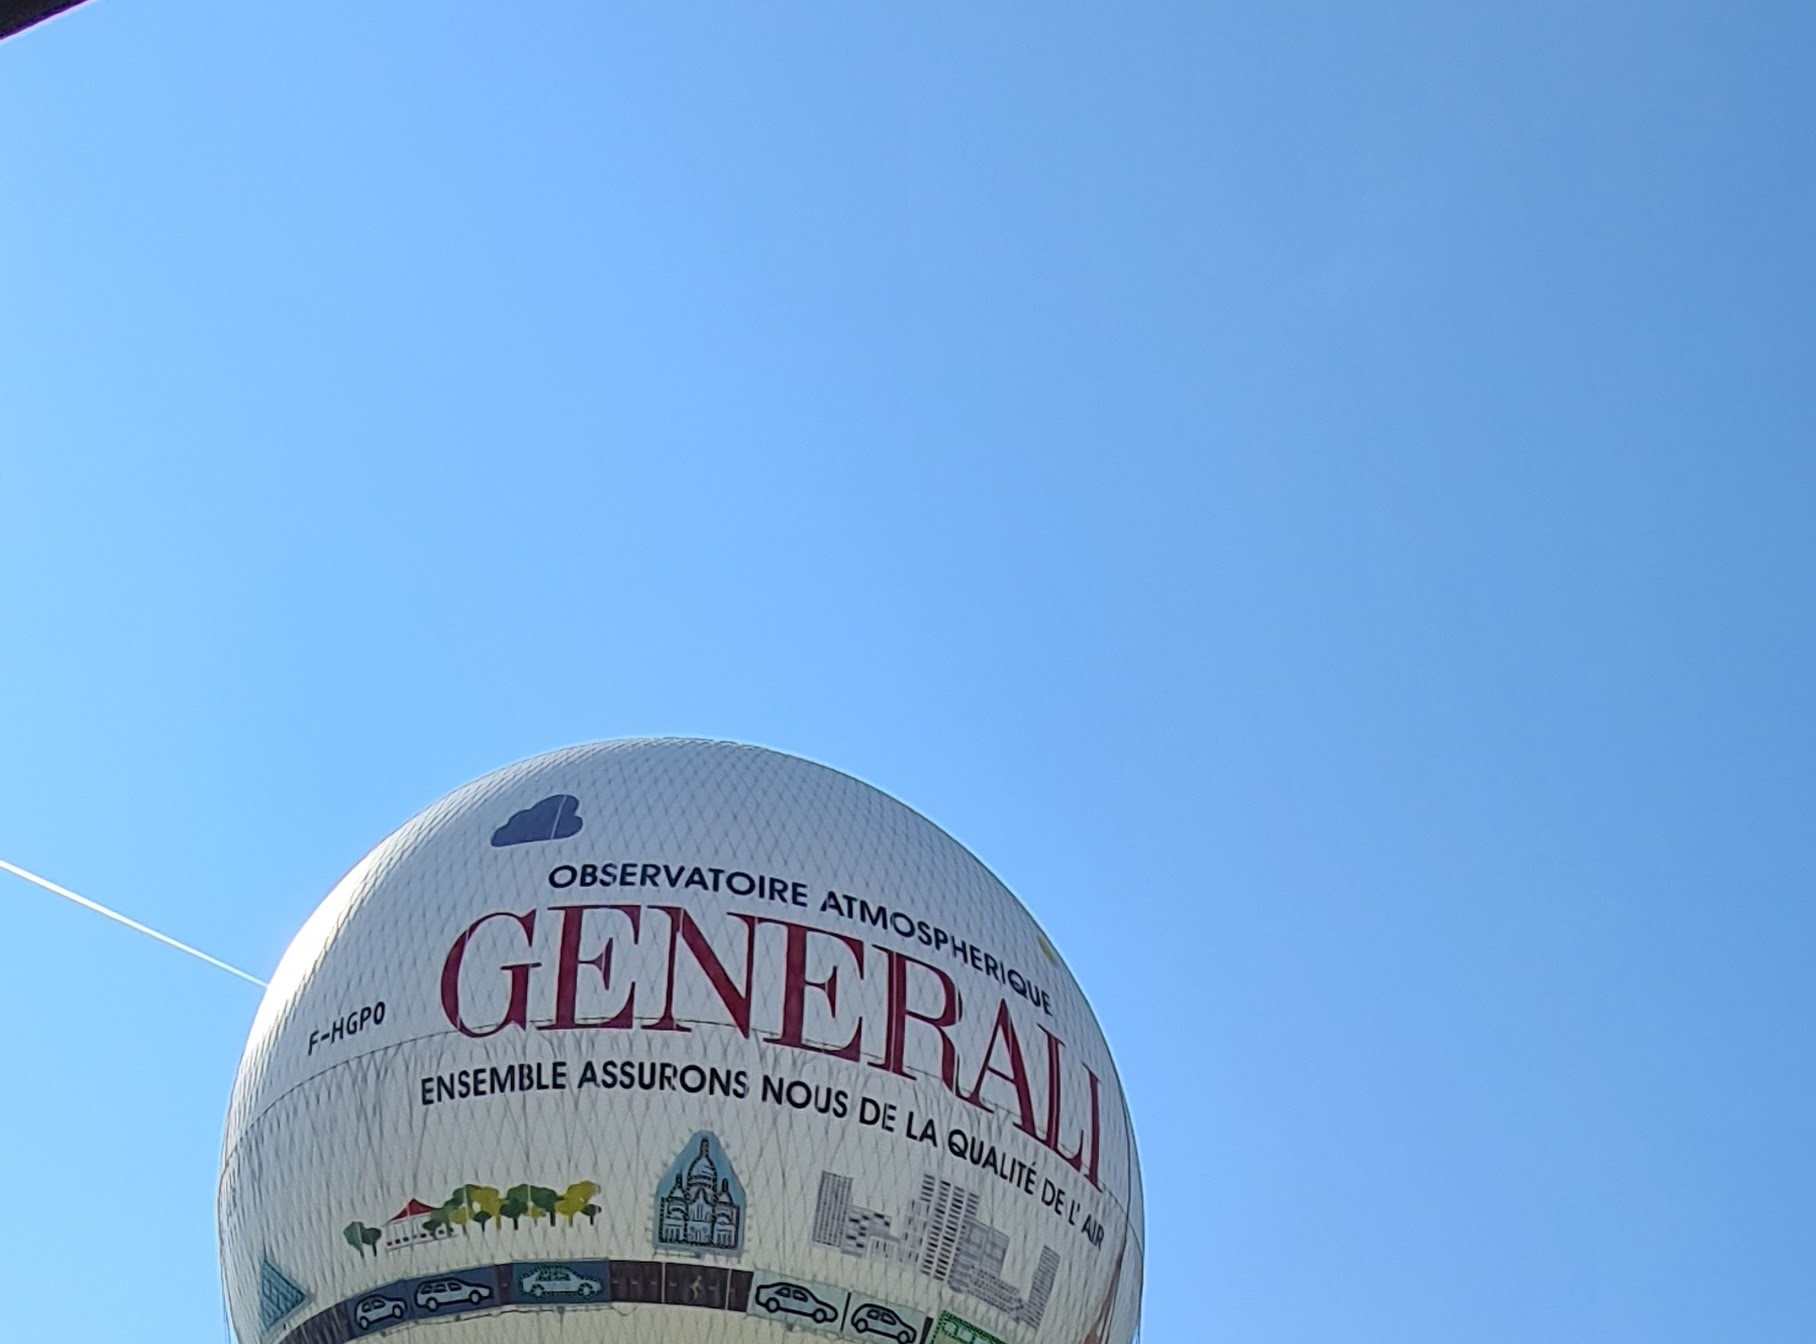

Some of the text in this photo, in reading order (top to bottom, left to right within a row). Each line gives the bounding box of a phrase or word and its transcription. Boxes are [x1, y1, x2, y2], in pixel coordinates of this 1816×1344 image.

[549, 863, 1053, 1016] OBSERVATOIRE ATMOSPHERIQUE
[440, 904, 1103, 1193] GENERALI
[421, 1061, 567, 1105] ENSEMBLE
[577, 1060, 748, 1099] ASSURONS
[761, 1074, 849, 1119] NOUS
[859, 1096, 897, 1133] DE
[906, 1111, 938, 1148] LA
[948, 1129, 1037, 1195] QUALITÉ
[1041, 1177, 1066, 1216] DE
